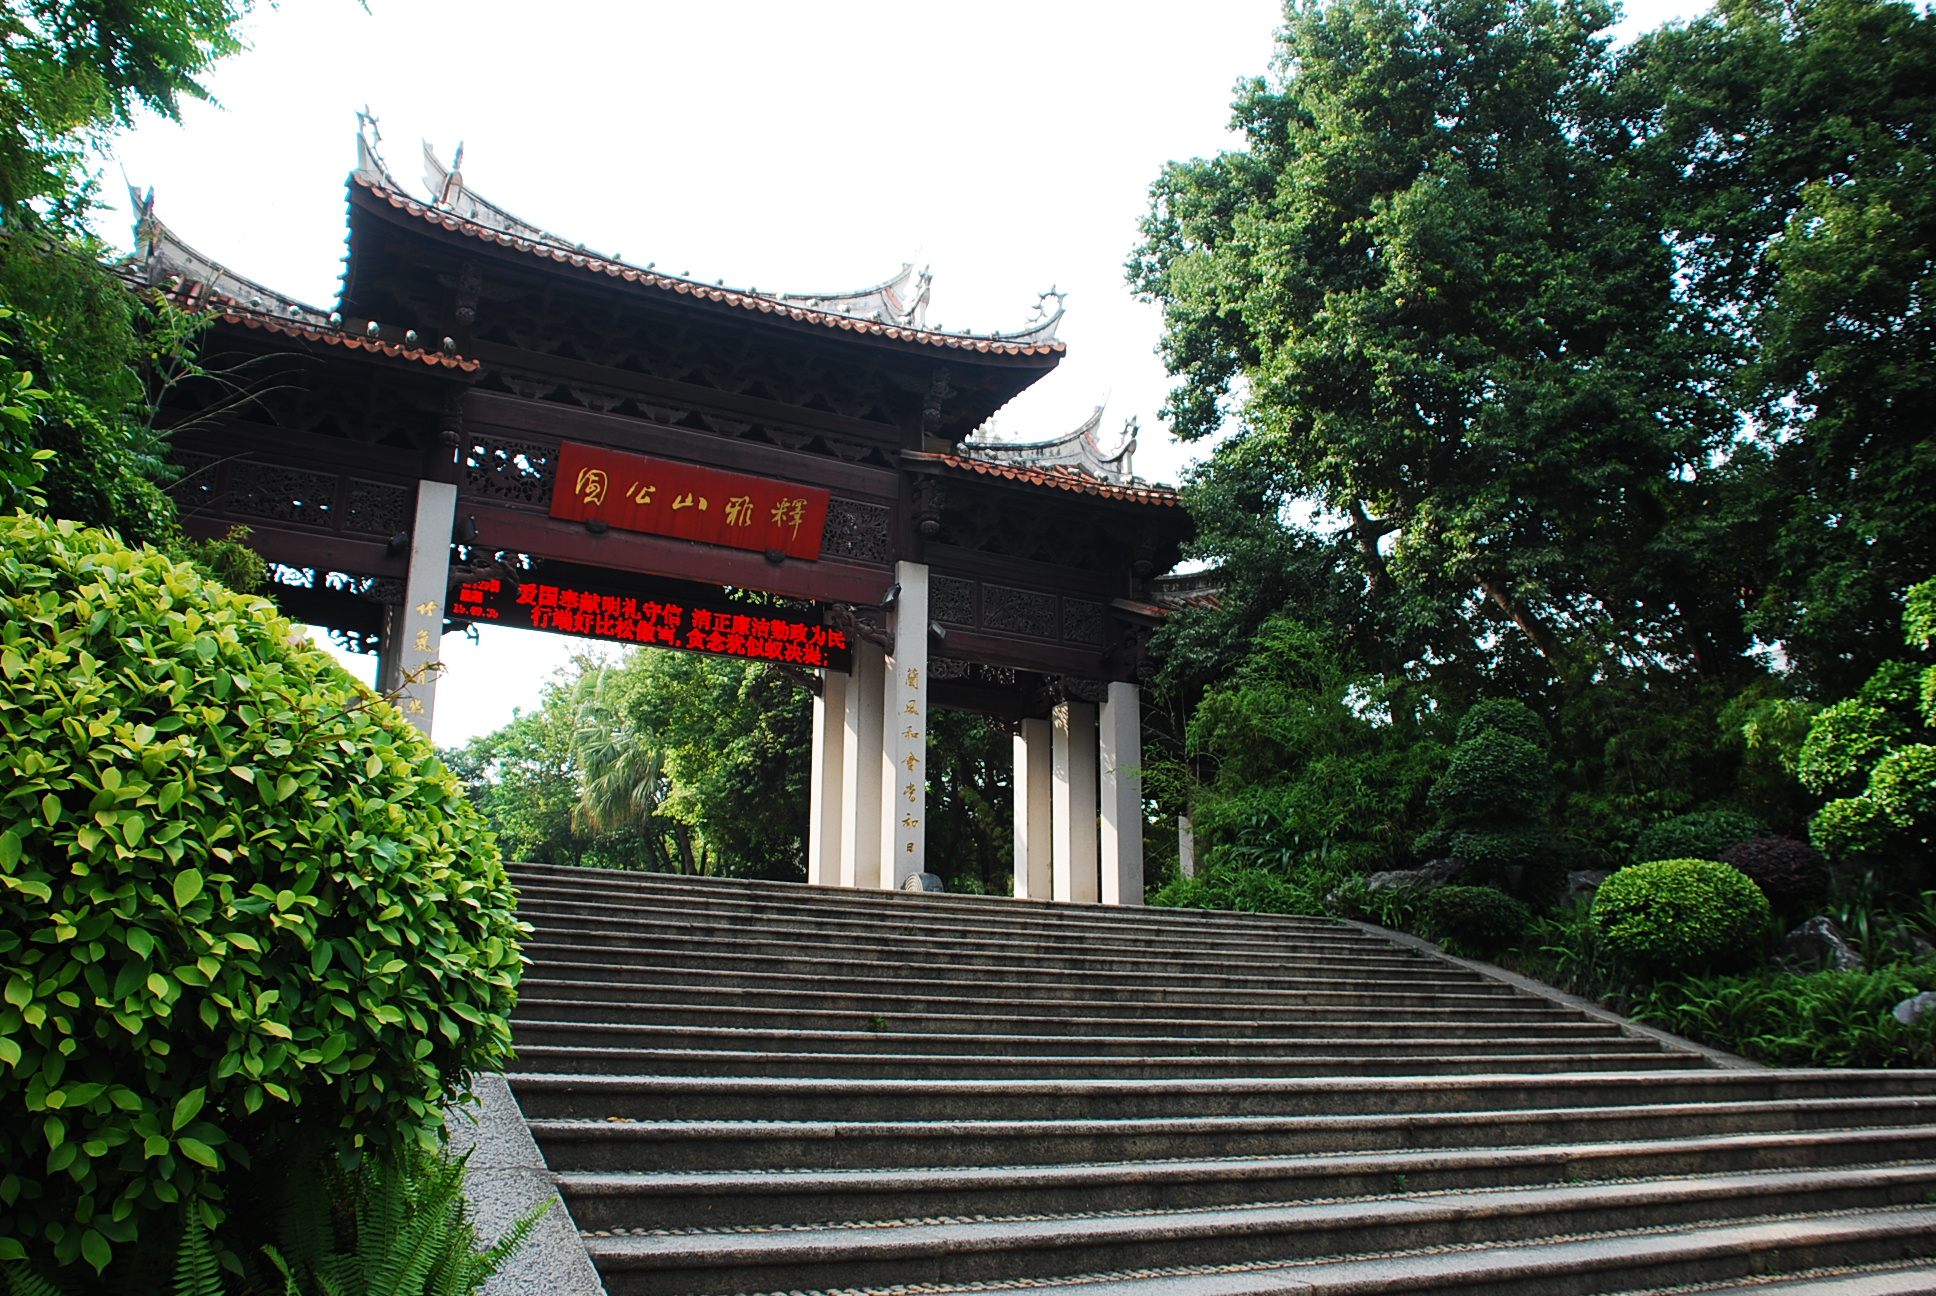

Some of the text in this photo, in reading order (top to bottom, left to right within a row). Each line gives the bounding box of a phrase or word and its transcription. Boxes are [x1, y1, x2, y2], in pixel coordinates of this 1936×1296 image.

[692, 608, 846, 650] 清正廉洁勤政为民
